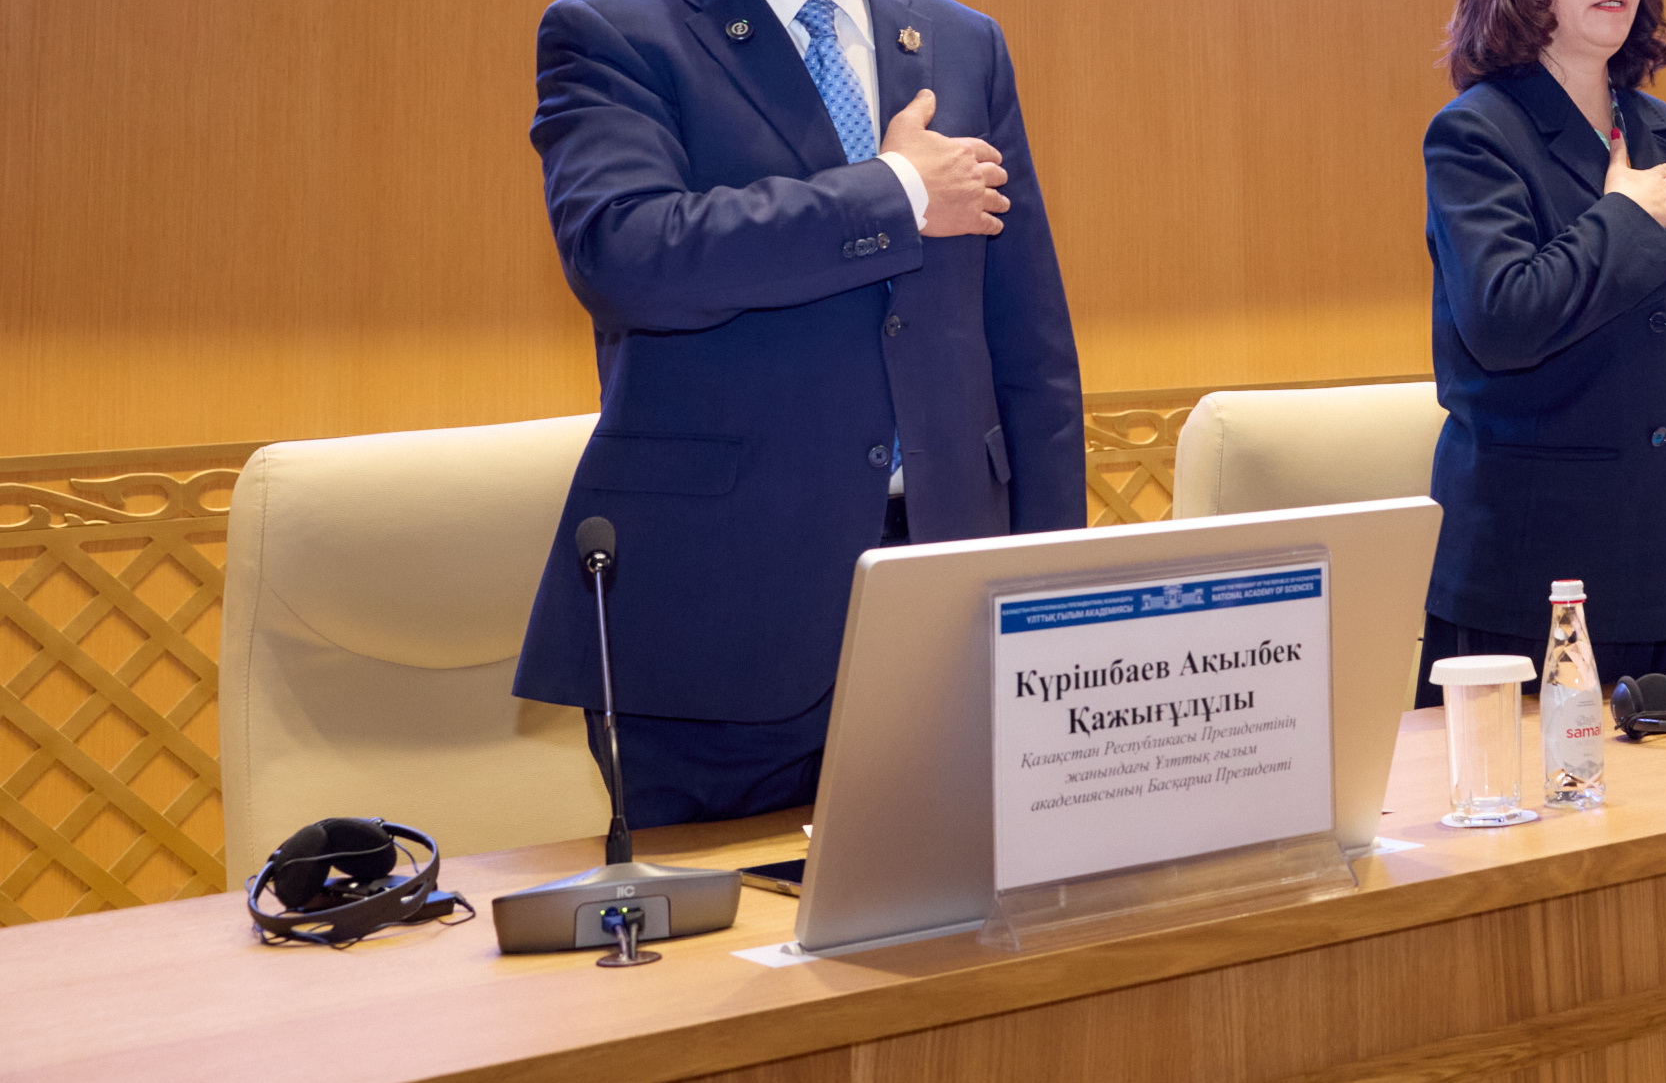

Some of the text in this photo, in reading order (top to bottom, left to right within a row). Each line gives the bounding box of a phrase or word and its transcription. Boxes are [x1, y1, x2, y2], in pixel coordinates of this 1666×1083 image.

[1015, 639, 1303, 702] Күрішбаев Ақылбек
[1069, 691, 1255, 738] Қажығұлұлы
[1021, 716, 1297, 768] Қазақстан Республикасы Президентінің
[1031, 757, 1293, 812] академиясының Басқарма Президенті
